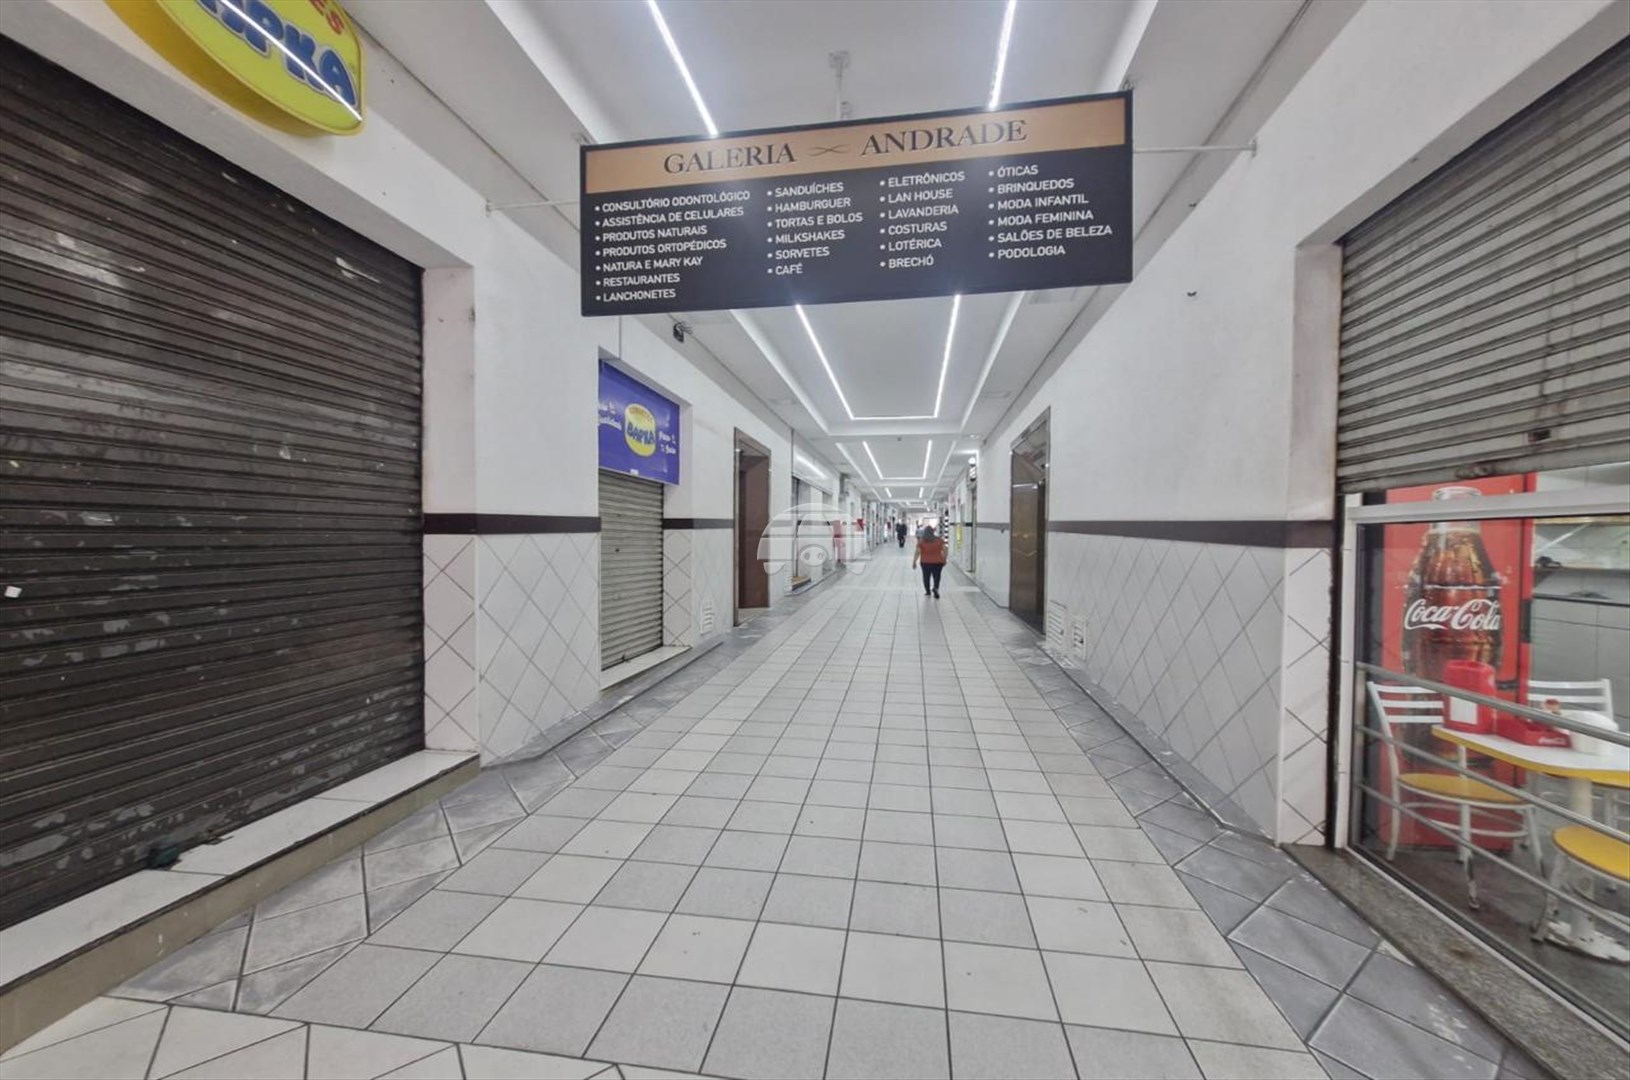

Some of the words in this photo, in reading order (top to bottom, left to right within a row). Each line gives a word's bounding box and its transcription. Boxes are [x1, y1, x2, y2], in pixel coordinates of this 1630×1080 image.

[664, 142, 797, 174] GALERIA
[860, 119, 1027, 156] ANDRADE
[888, 171, 965, 188] ELETRÔNICOS
[997, 165, 1039, 178] ÓTICAS
[775, 182, 844, 198] SANDUÍCHES
[997, 178, 1075, 195] BRINQUEDOS
[602, 196, 670, 213] CONSULTÓRIO
[672, 190, 750, 209] ODONTOLÓGICO
[888, 192, 911, 203] LAN
[913, 188, 953, 201] HOUSE
[998, 198, 1032, 211] MODA
[1034, 193, 1089, 208] INFANTIL
[775, 197, 851, 213] HAMBURGUER
[888, 204, 959, 219] LAVANDERIA
[602, 211, 667, 227] ASSISTÊNCIA
[668, 211, 682, 222] DE
[684, 207, 744, 221] CELULARES
[775, 216, 815, 229] TORTAS
[817, 215, 824, 226] E
[826, 212, 863, 225] BOLOS
[998, 215, 1032, 227] MODA
[1034, 210, 1094, 224] FEMININA
[603, 229, 655, 242] PRODUTOS
[657, 225, 707, 238] NATURAIS
[888, 221, 947, 235] COSTURAS
[998, 229, 1044, 243] SALÕES
[1046, 229, 1063, 239] DE
[1065, 225, 1112, 238] BELEZA
[775, 229, 845, 244] MILKSHAKES
[888, 238, 942, 251] LOTÉRICA
[603, 244, 655, 257] PRODUTOS
[657, 238, 727, 254] ORTOPÉDICOS
[775, 247, 830, 260] SORVETES
[998, 245, 1065, 259] PODOLOGIA
[603, 261, 642, 273] NATURA
[644, 260, 651, 270] E
[653, 258, 681, 269] MARY
[683, 256, 703, 266] KAY
[775, 263, 803, 275] CAFÉ
[888, 255, 934, 268] BRECHÓ
[603, 273, 680, 287] RESTAURANTES
[603, 289, 676, 302] LANCHONETES
[1404, 598, 1500, 630] Coca-Cola
